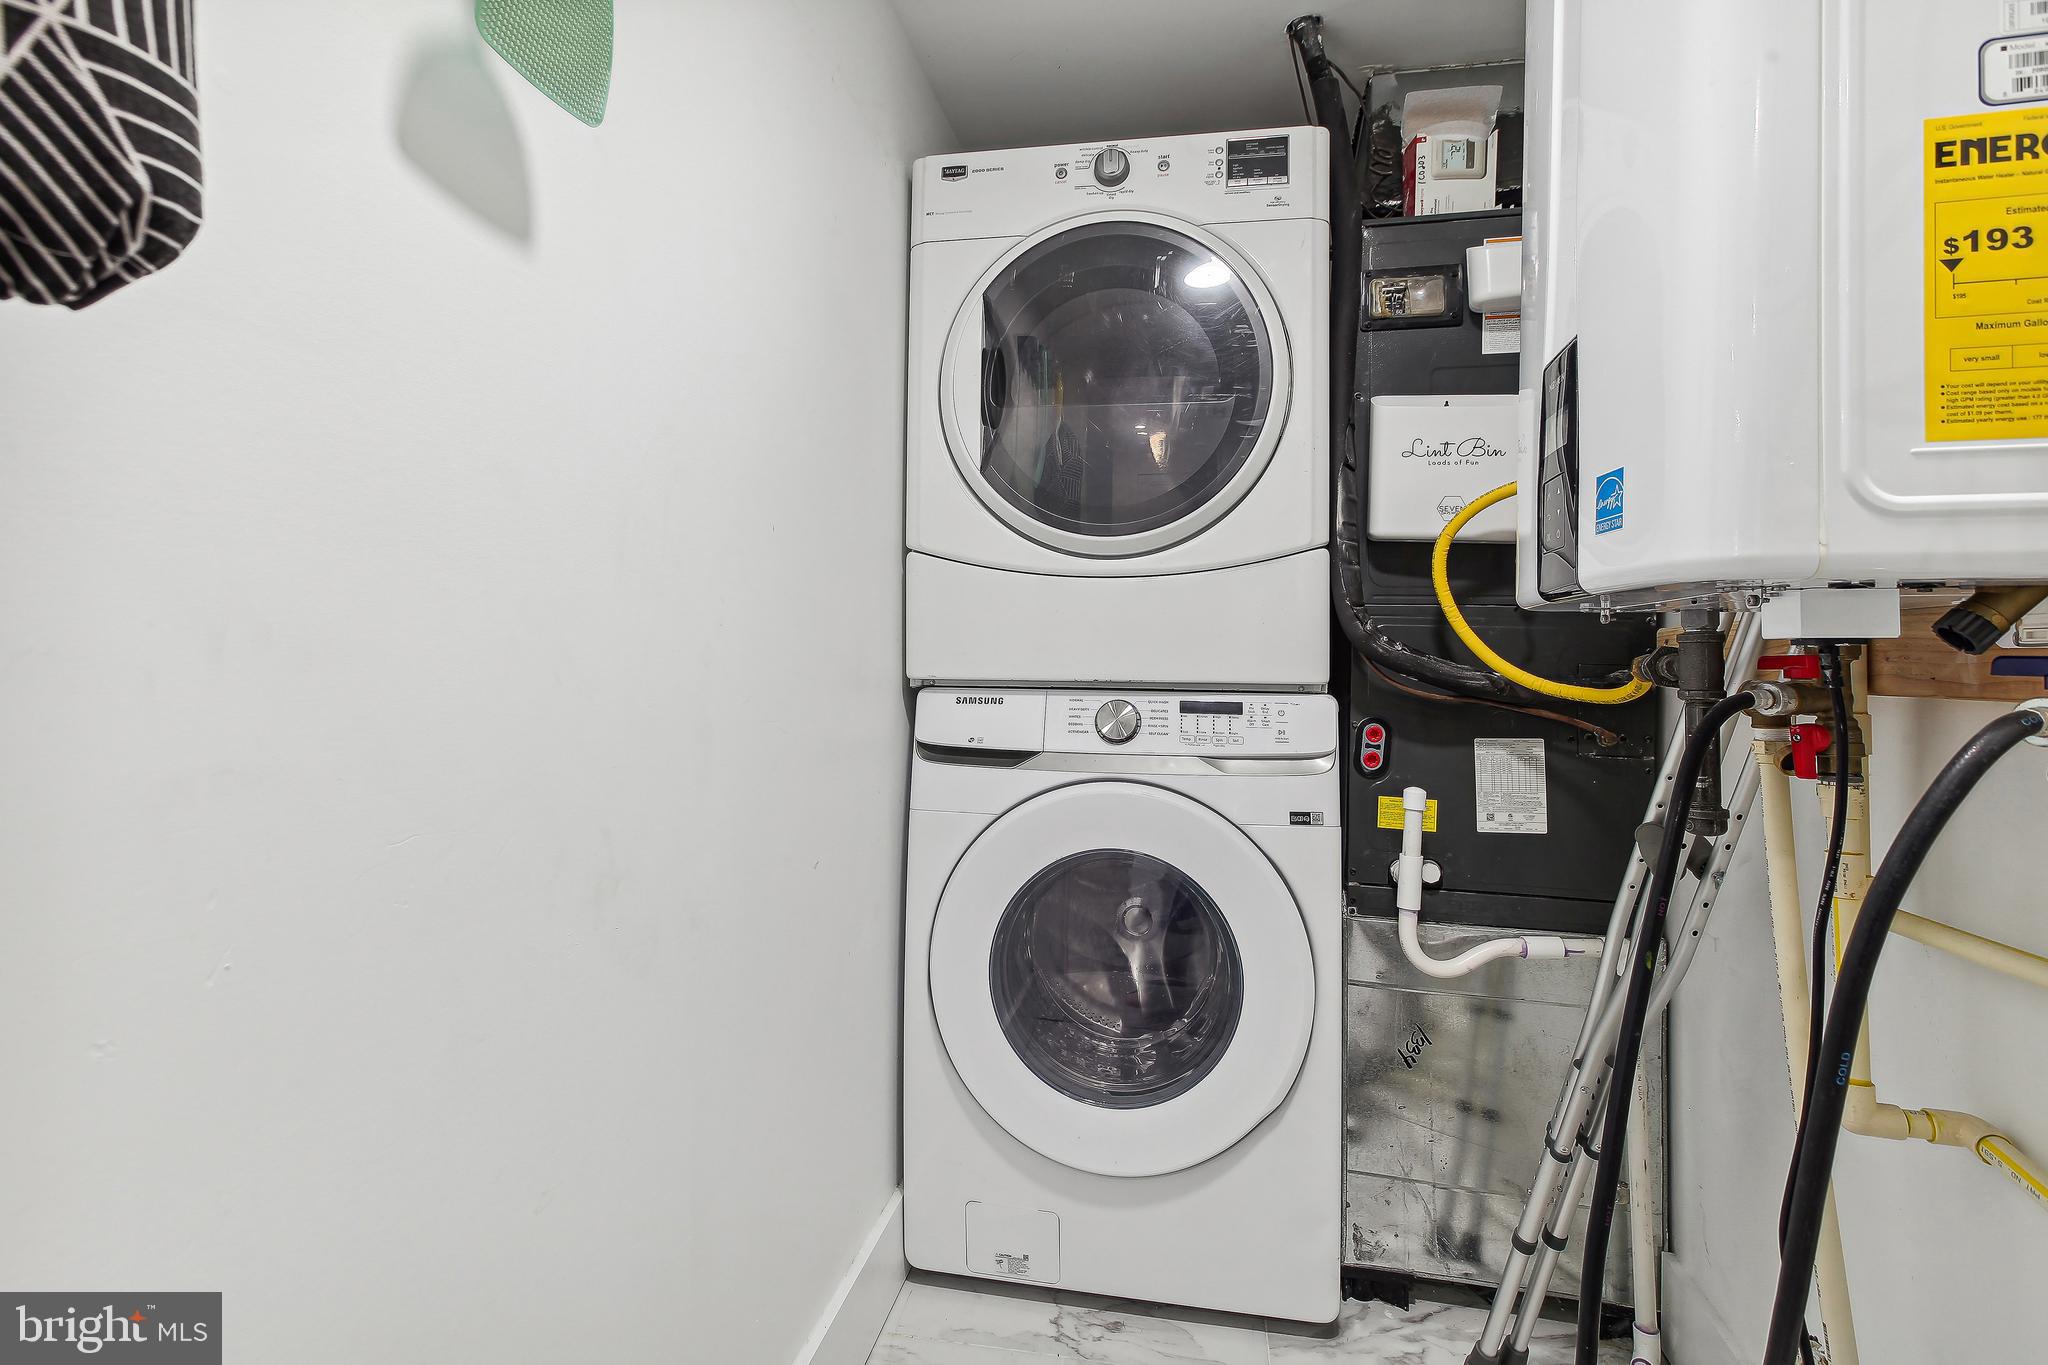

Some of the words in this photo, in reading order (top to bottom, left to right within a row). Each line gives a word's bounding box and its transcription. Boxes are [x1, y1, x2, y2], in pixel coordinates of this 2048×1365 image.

[1943, 225, 2034, 256] $193
[1976, 321, 2021, 330] Maximum
[1401, 438, 1455, 458] Lint
[1456, 437, 1506, 458] Bin
[955, 696, 1004, 705] SAMSUNG
[1836, 1052, 1850, 1086] COLD
